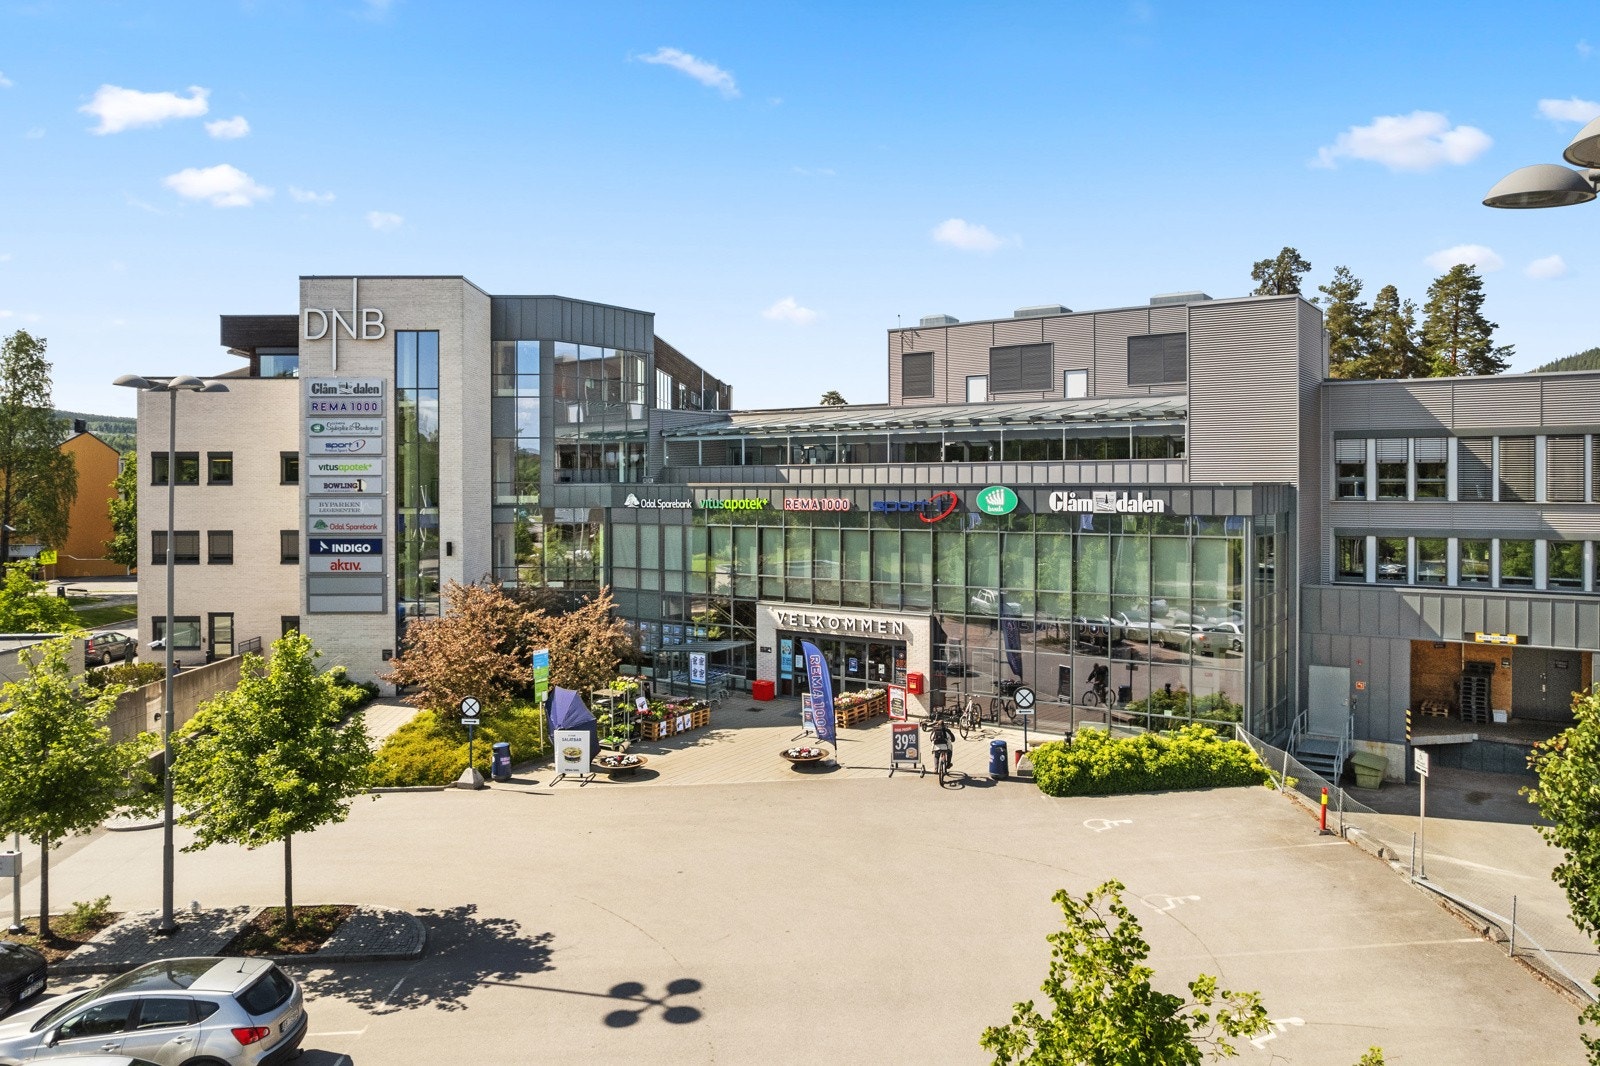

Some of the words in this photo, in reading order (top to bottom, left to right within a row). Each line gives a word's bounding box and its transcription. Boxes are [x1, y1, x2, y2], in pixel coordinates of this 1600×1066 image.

[311, 383, 337, 394] Glåm
[353, 382, 379, 394] dalen
[312, 403, 347, 411] REMA
[351, 403, 377, 411] 1000
[357, 479, 363, 492] 1
[640, 498, 656, 508] Odal
[657, 498, 692, 510] Sparebank
[784, 498, 818, 511] REMA
[821, 498, 850, 511] 1000
[872, 500, 930, 515] sport
[1049, 491, 1093, 512] Glåm
[1116, 492, 1164, 513] dalen
[345, 523, 377, 531] Sparebank
[332, 544, 371, 552] INDIGO
[776, 611, 904, 635] VELKOMMEN
[810, 654, 824, 699] REMA
[814, 702, 827, 736] 1000
[895, 733, 909, 750] 39
[908, 734, 916, 742] 90
